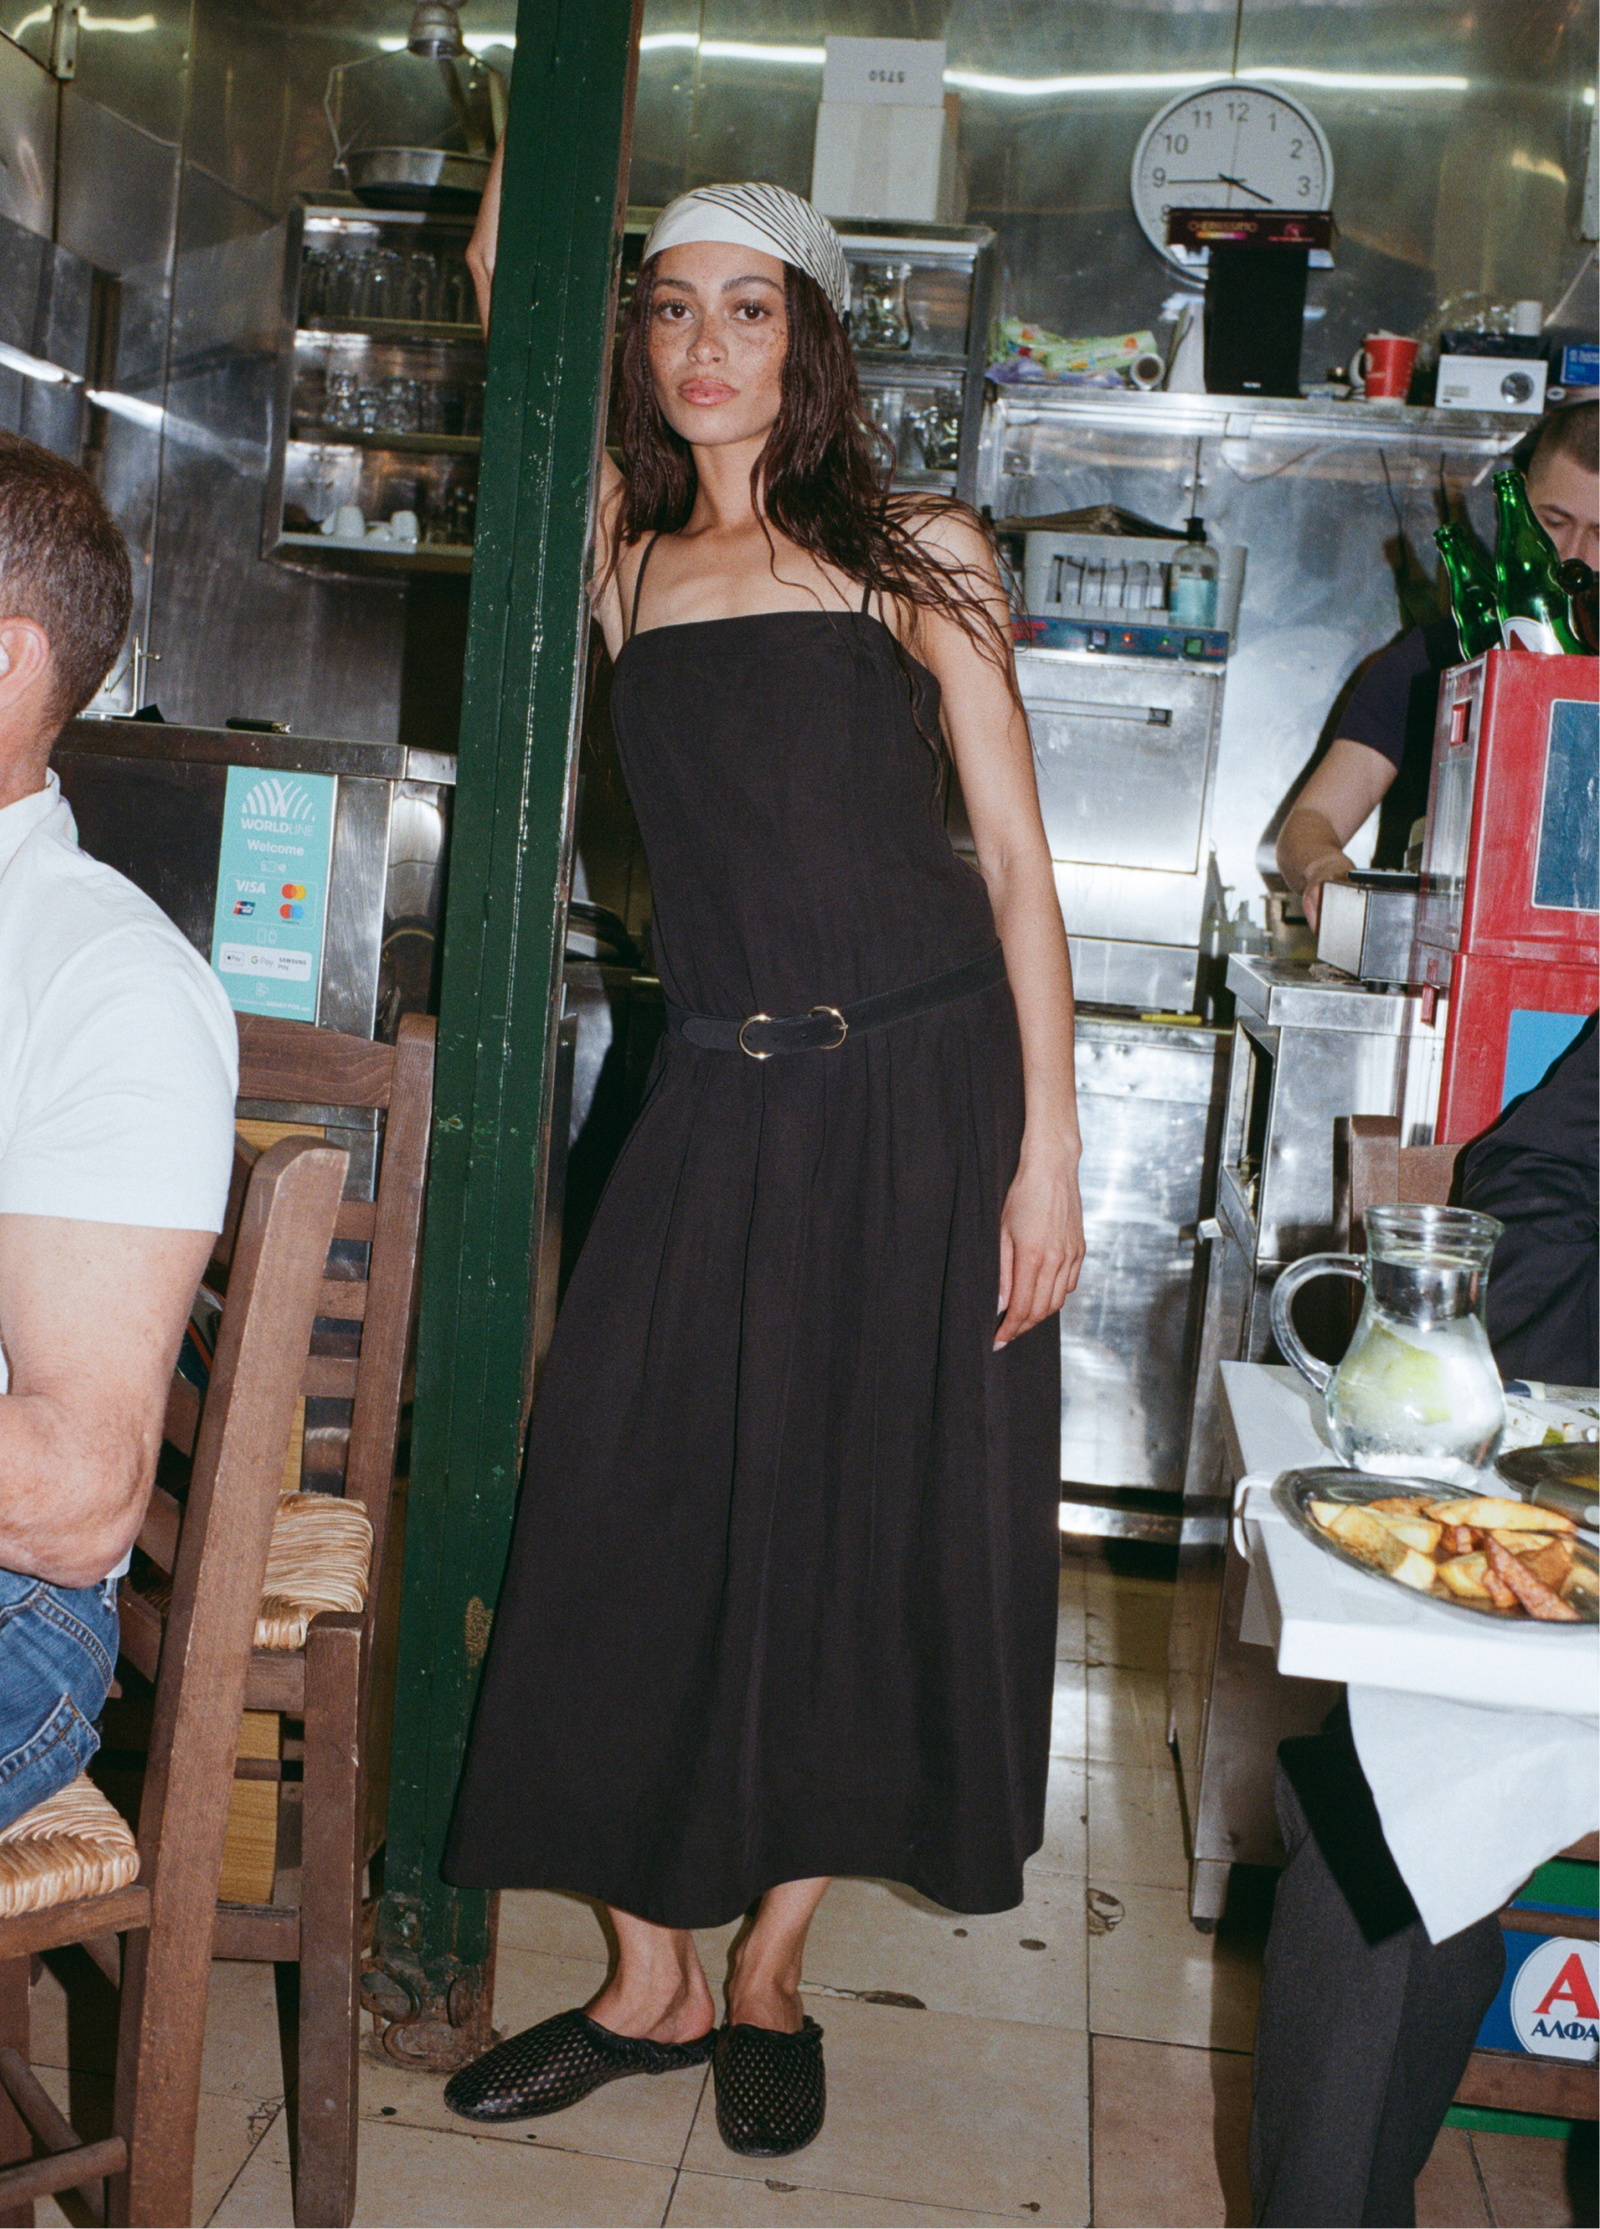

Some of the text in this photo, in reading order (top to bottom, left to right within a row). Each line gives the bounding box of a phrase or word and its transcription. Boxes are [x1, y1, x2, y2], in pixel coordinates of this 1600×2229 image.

[1194, 110, 1212, 130] 11
[1227, 102, 1248, 122] 12
[1268, 113, 1277, 132] 1
[1165, 133, 1189, 155] 10
[1290, 138, 1303, 159] 2
[1152, 167, 1166, 188] 9
[1298, 175, 1311, 197] 3
[241, 818, 314, 836] WORLDLINE
[247, 839, 304, 856] Welcome
[235, 880, 266, 894] VISA
[260, 957, 274, 968] Pay
[279, 957, 307, 965] SAMSUNG
[1531, 2019, 1600, 2042] ΑΛΦΑ
